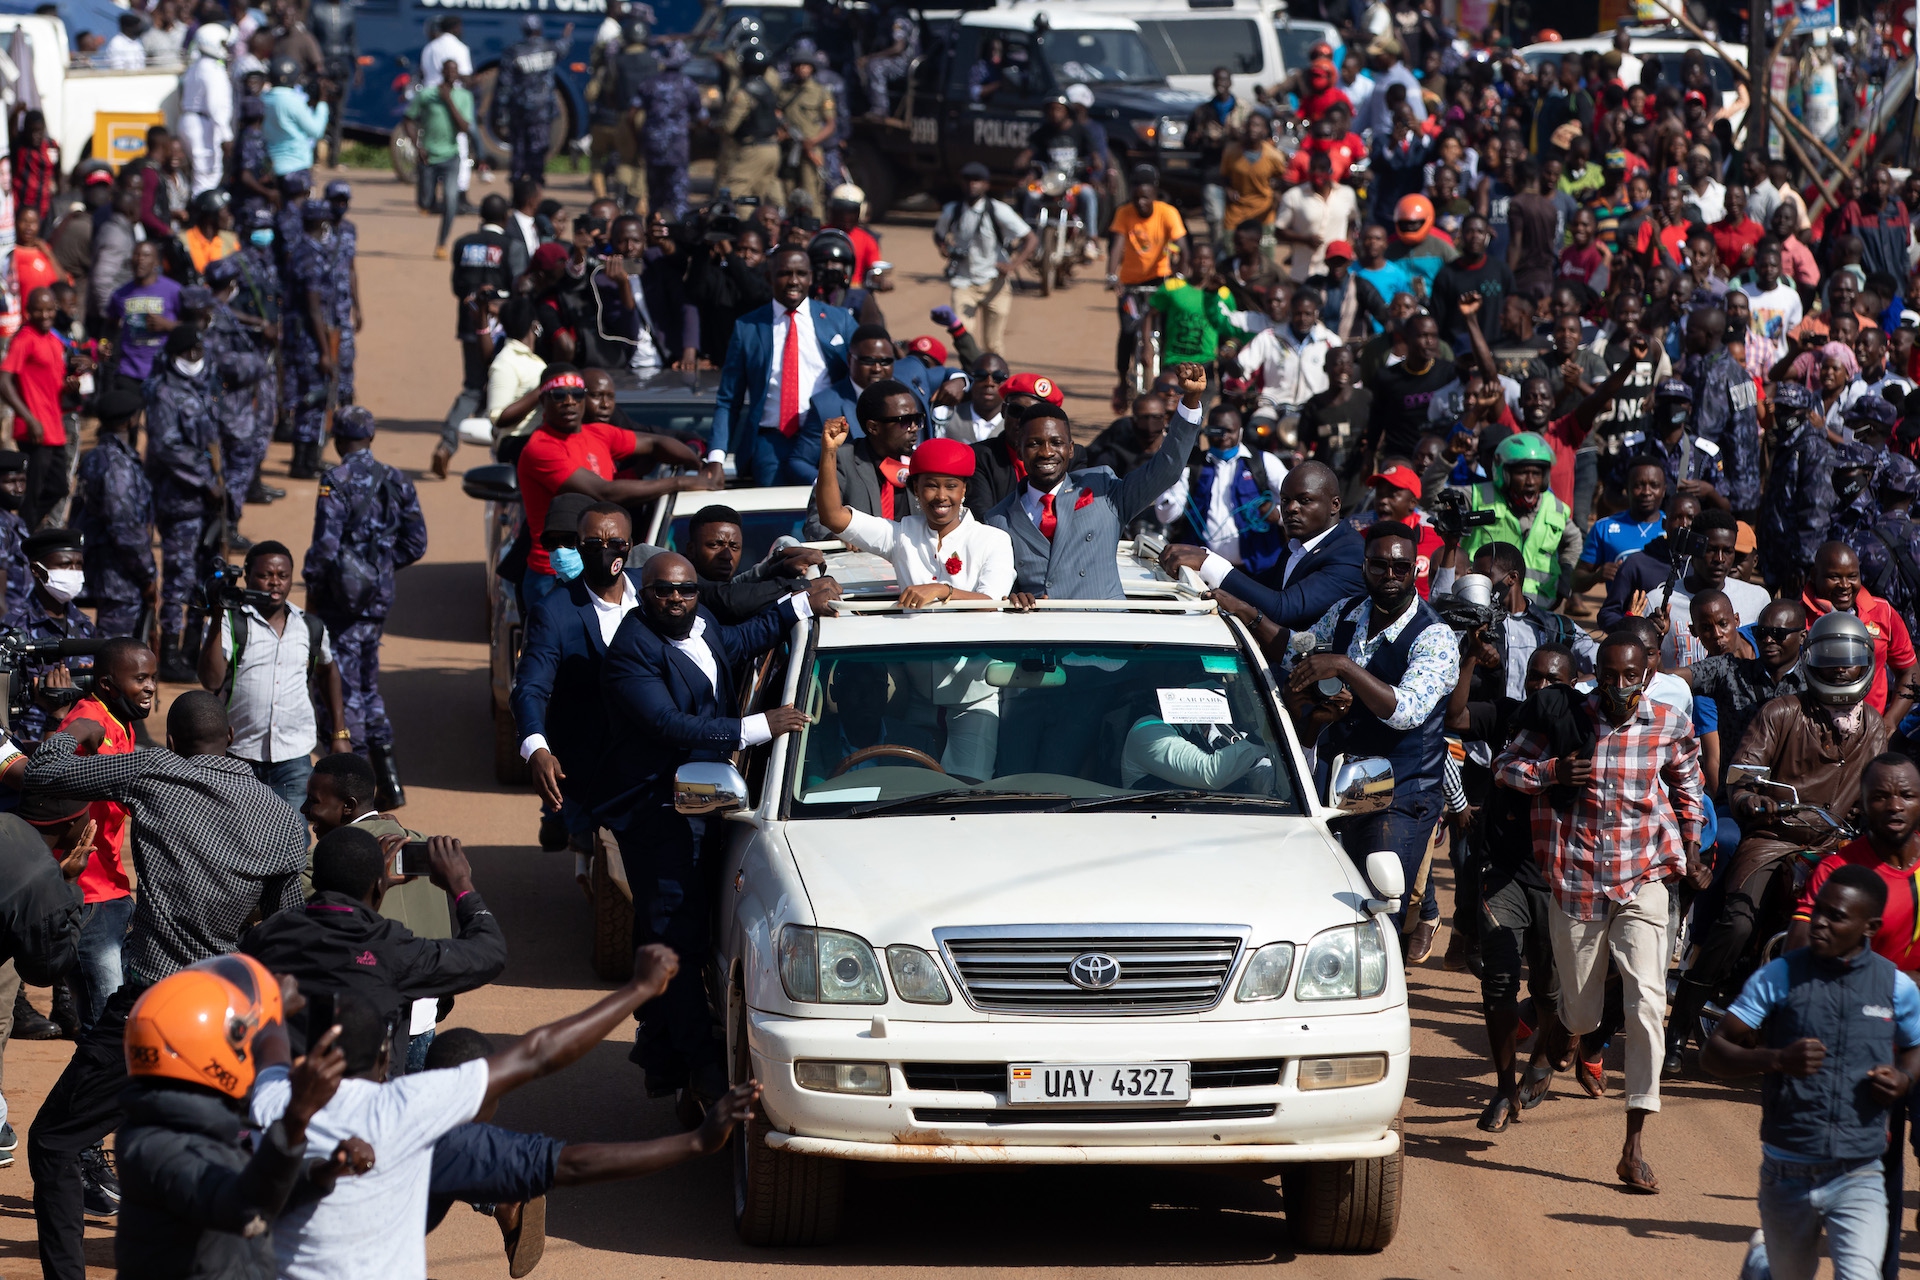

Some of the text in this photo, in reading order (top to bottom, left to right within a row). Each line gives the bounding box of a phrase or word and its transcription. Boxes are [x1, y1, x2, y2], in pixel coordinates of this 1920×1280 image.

[974, 118, 1029, 147] POLICE
[203, 1058, 239, 1091] 2983
[1044, 1068, 1175, 1098] UAY 432Z
